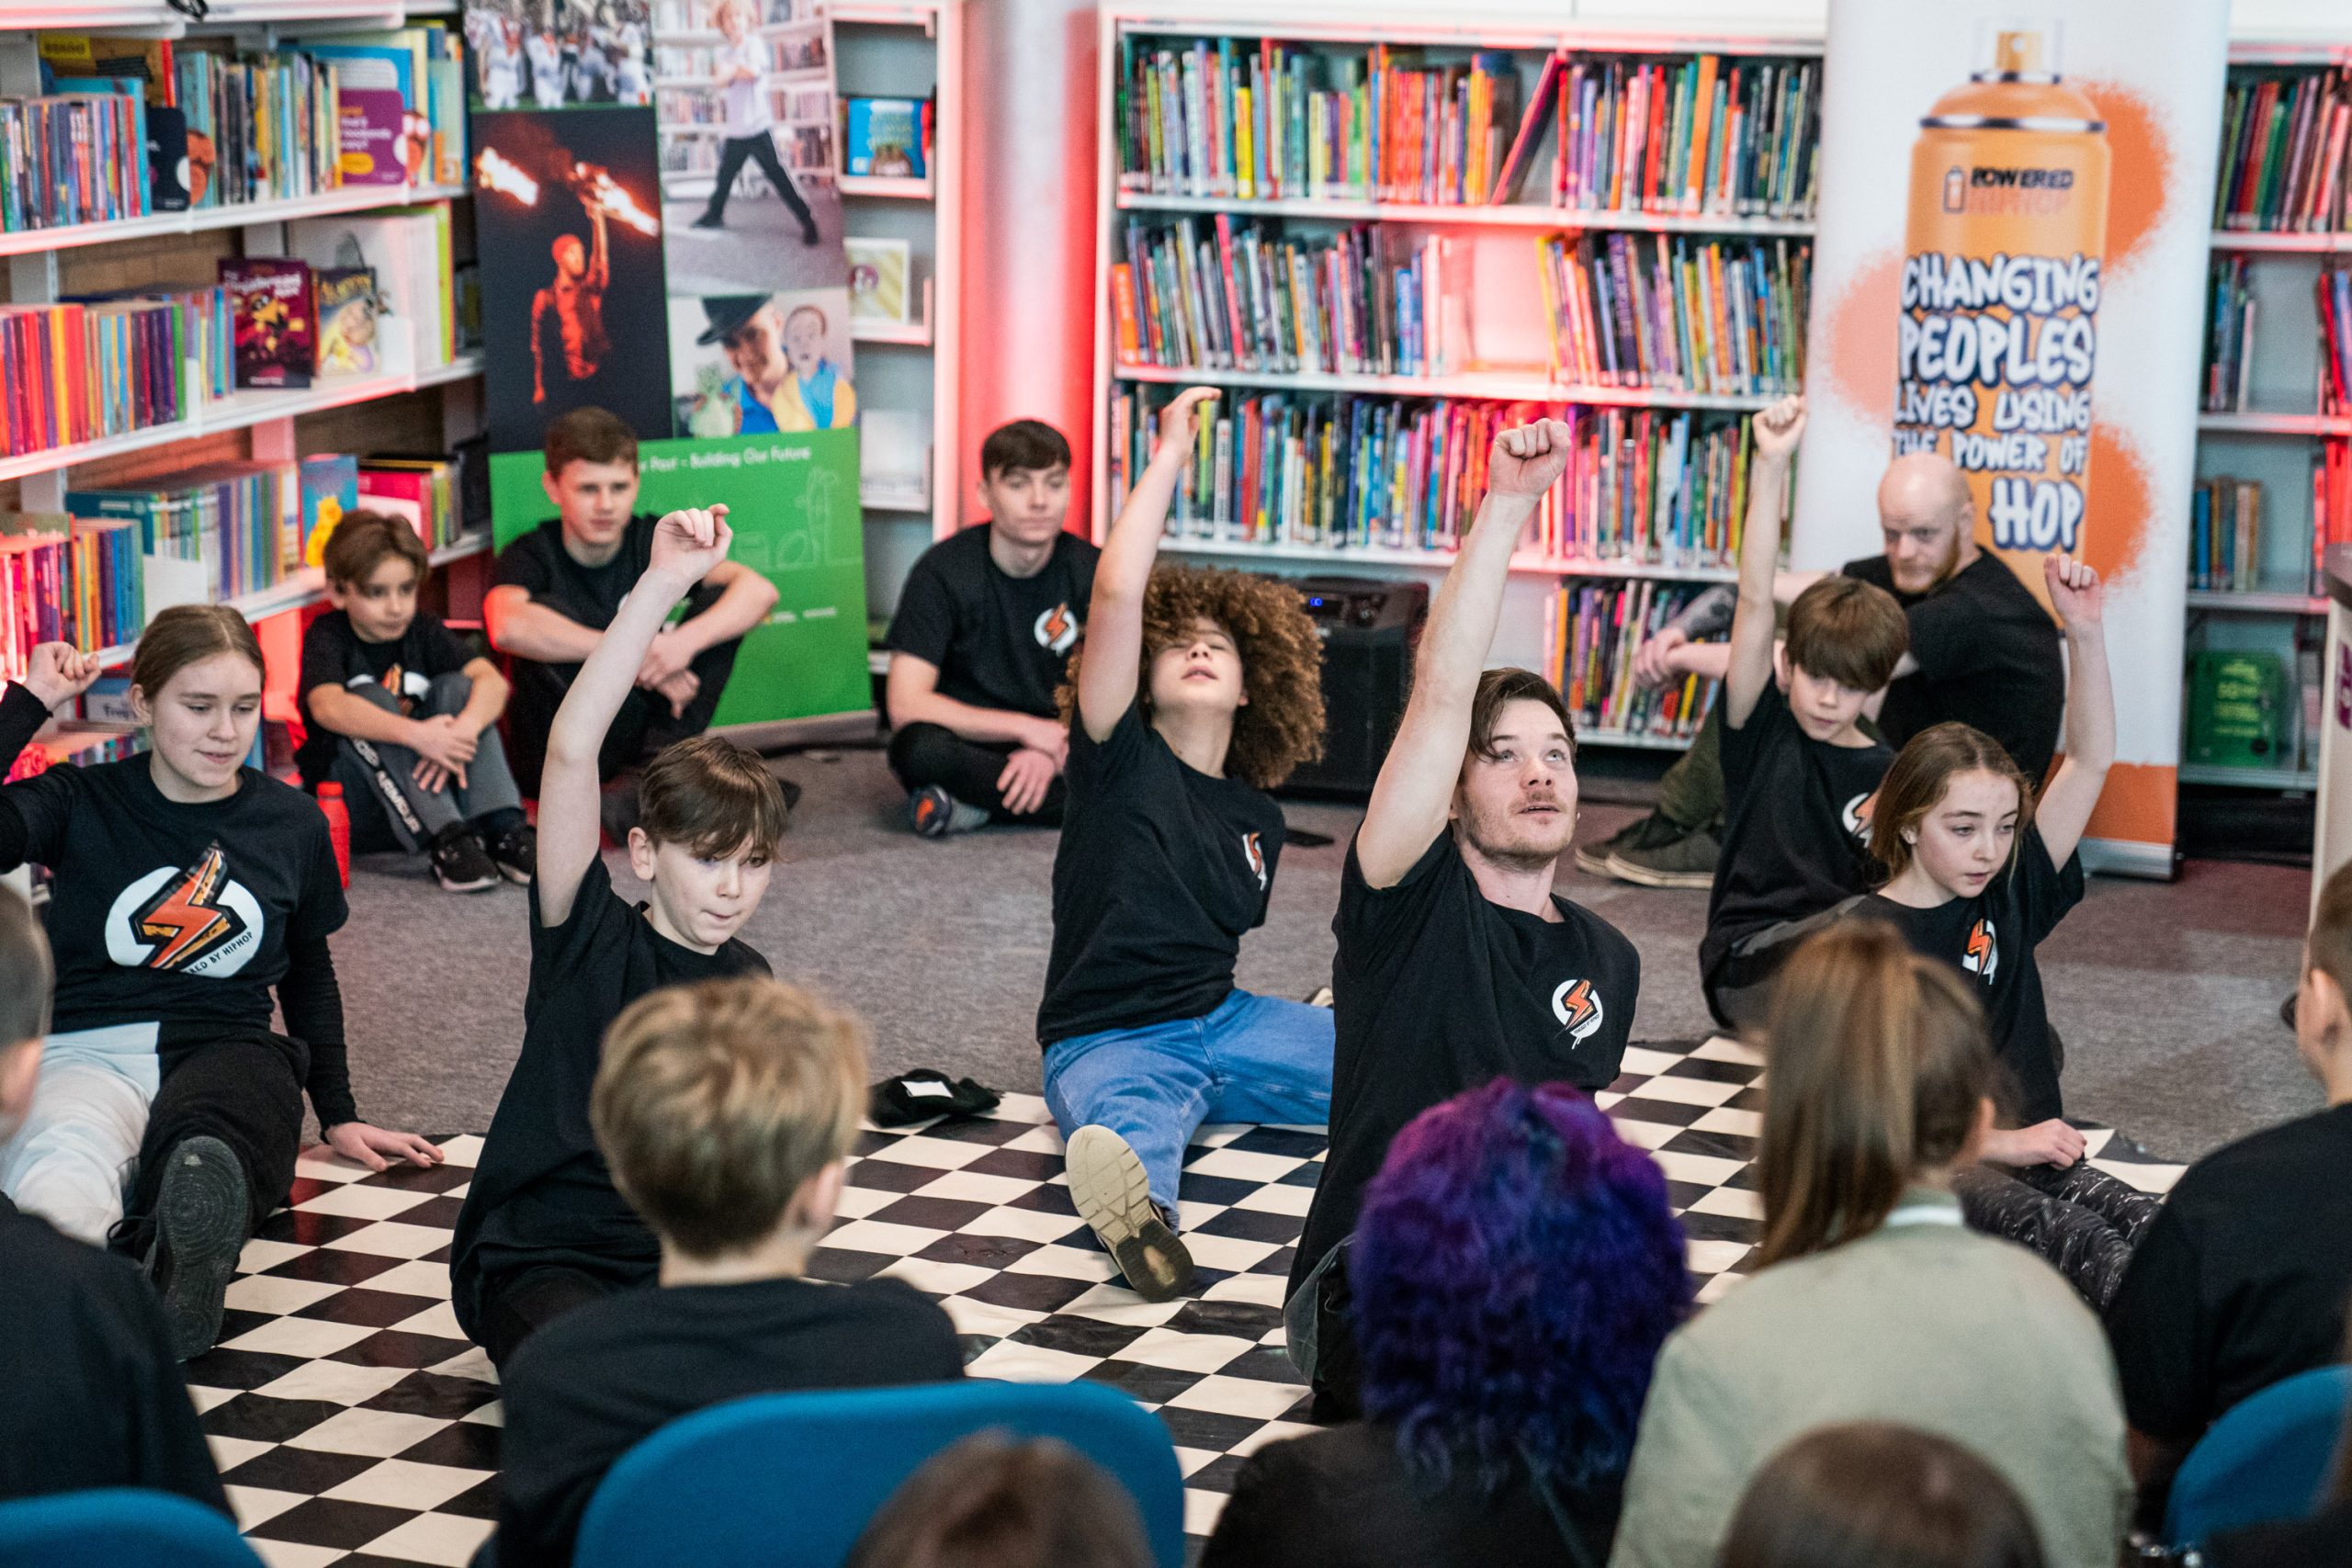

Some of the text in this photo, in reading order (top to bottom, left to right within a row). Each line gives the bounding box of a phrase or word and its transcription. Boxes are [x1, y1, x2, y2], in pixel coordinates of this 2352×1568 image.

[1902, 254, 2101, 314] CHANGING
[1898, 313, 2097, 388] PEOPLES
[1893, 380, 2092, 434] LIVES USING
[1951, 431, 2049, 472] POWER
[2060, 435, 2089, 475] OF
[1989, 477, 2083, 551] HOP
[209, 953, 220, 964] BY
[222, 931, 253, 955] HIPHOP
